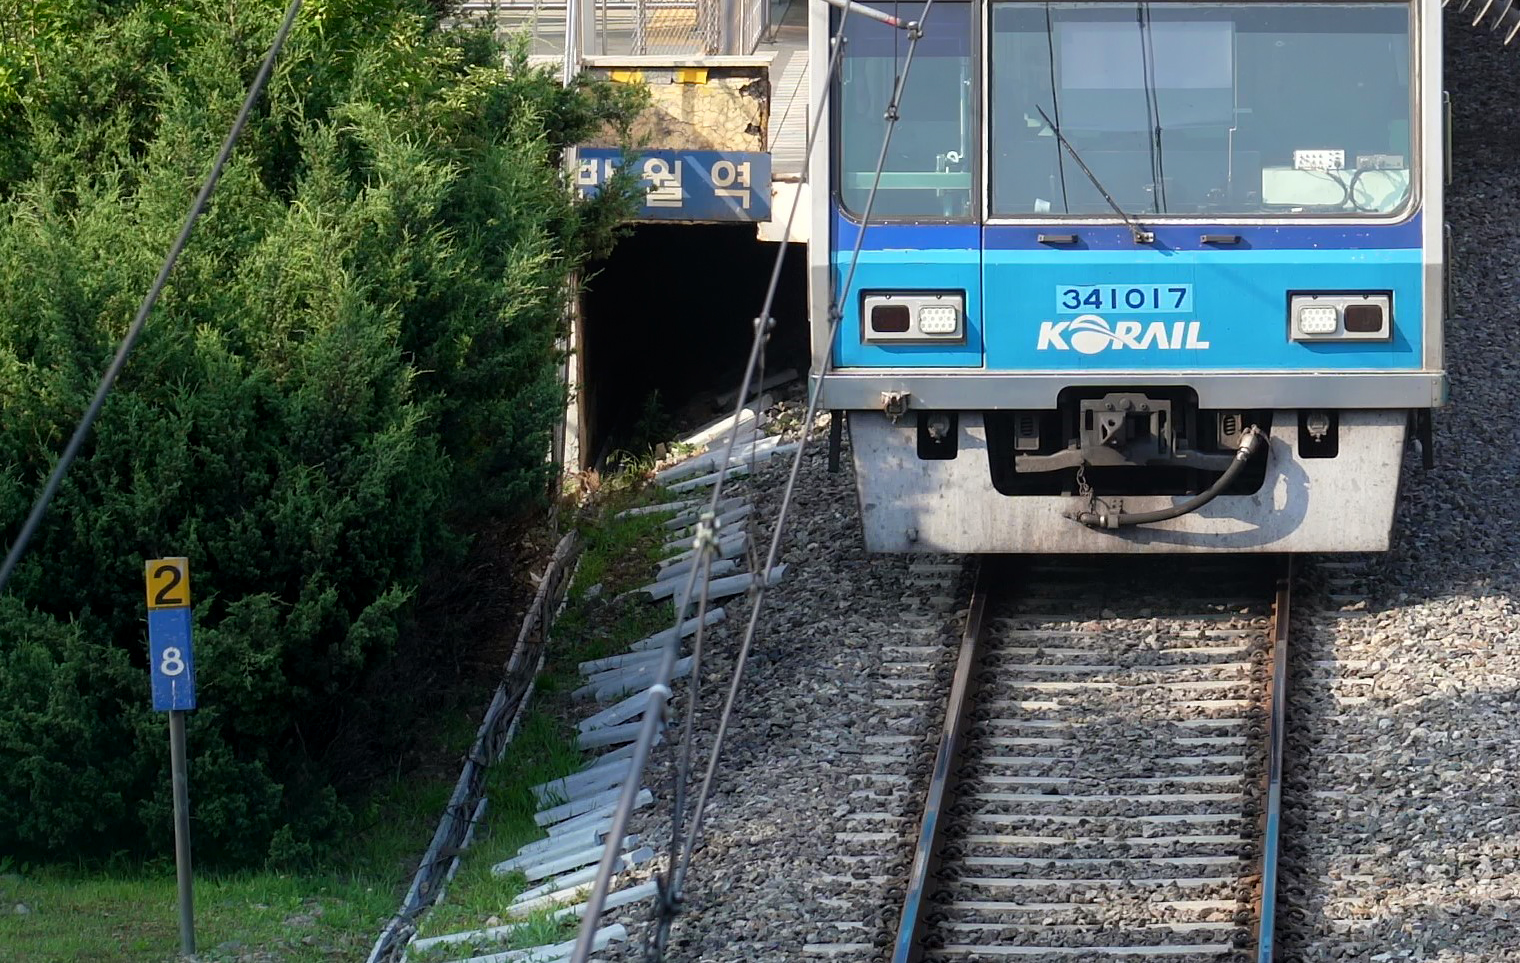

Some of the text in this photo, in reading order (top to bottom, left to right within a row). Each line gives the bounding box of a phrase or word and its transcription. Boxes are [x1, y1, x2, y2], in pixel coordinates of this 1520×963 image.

[1062, 288, 1187, 309] 341017
[1036, 314, 1210, 355] KORAIL
[153, 565, 182, 605] 2
[160, 646, 185, 676] 8
